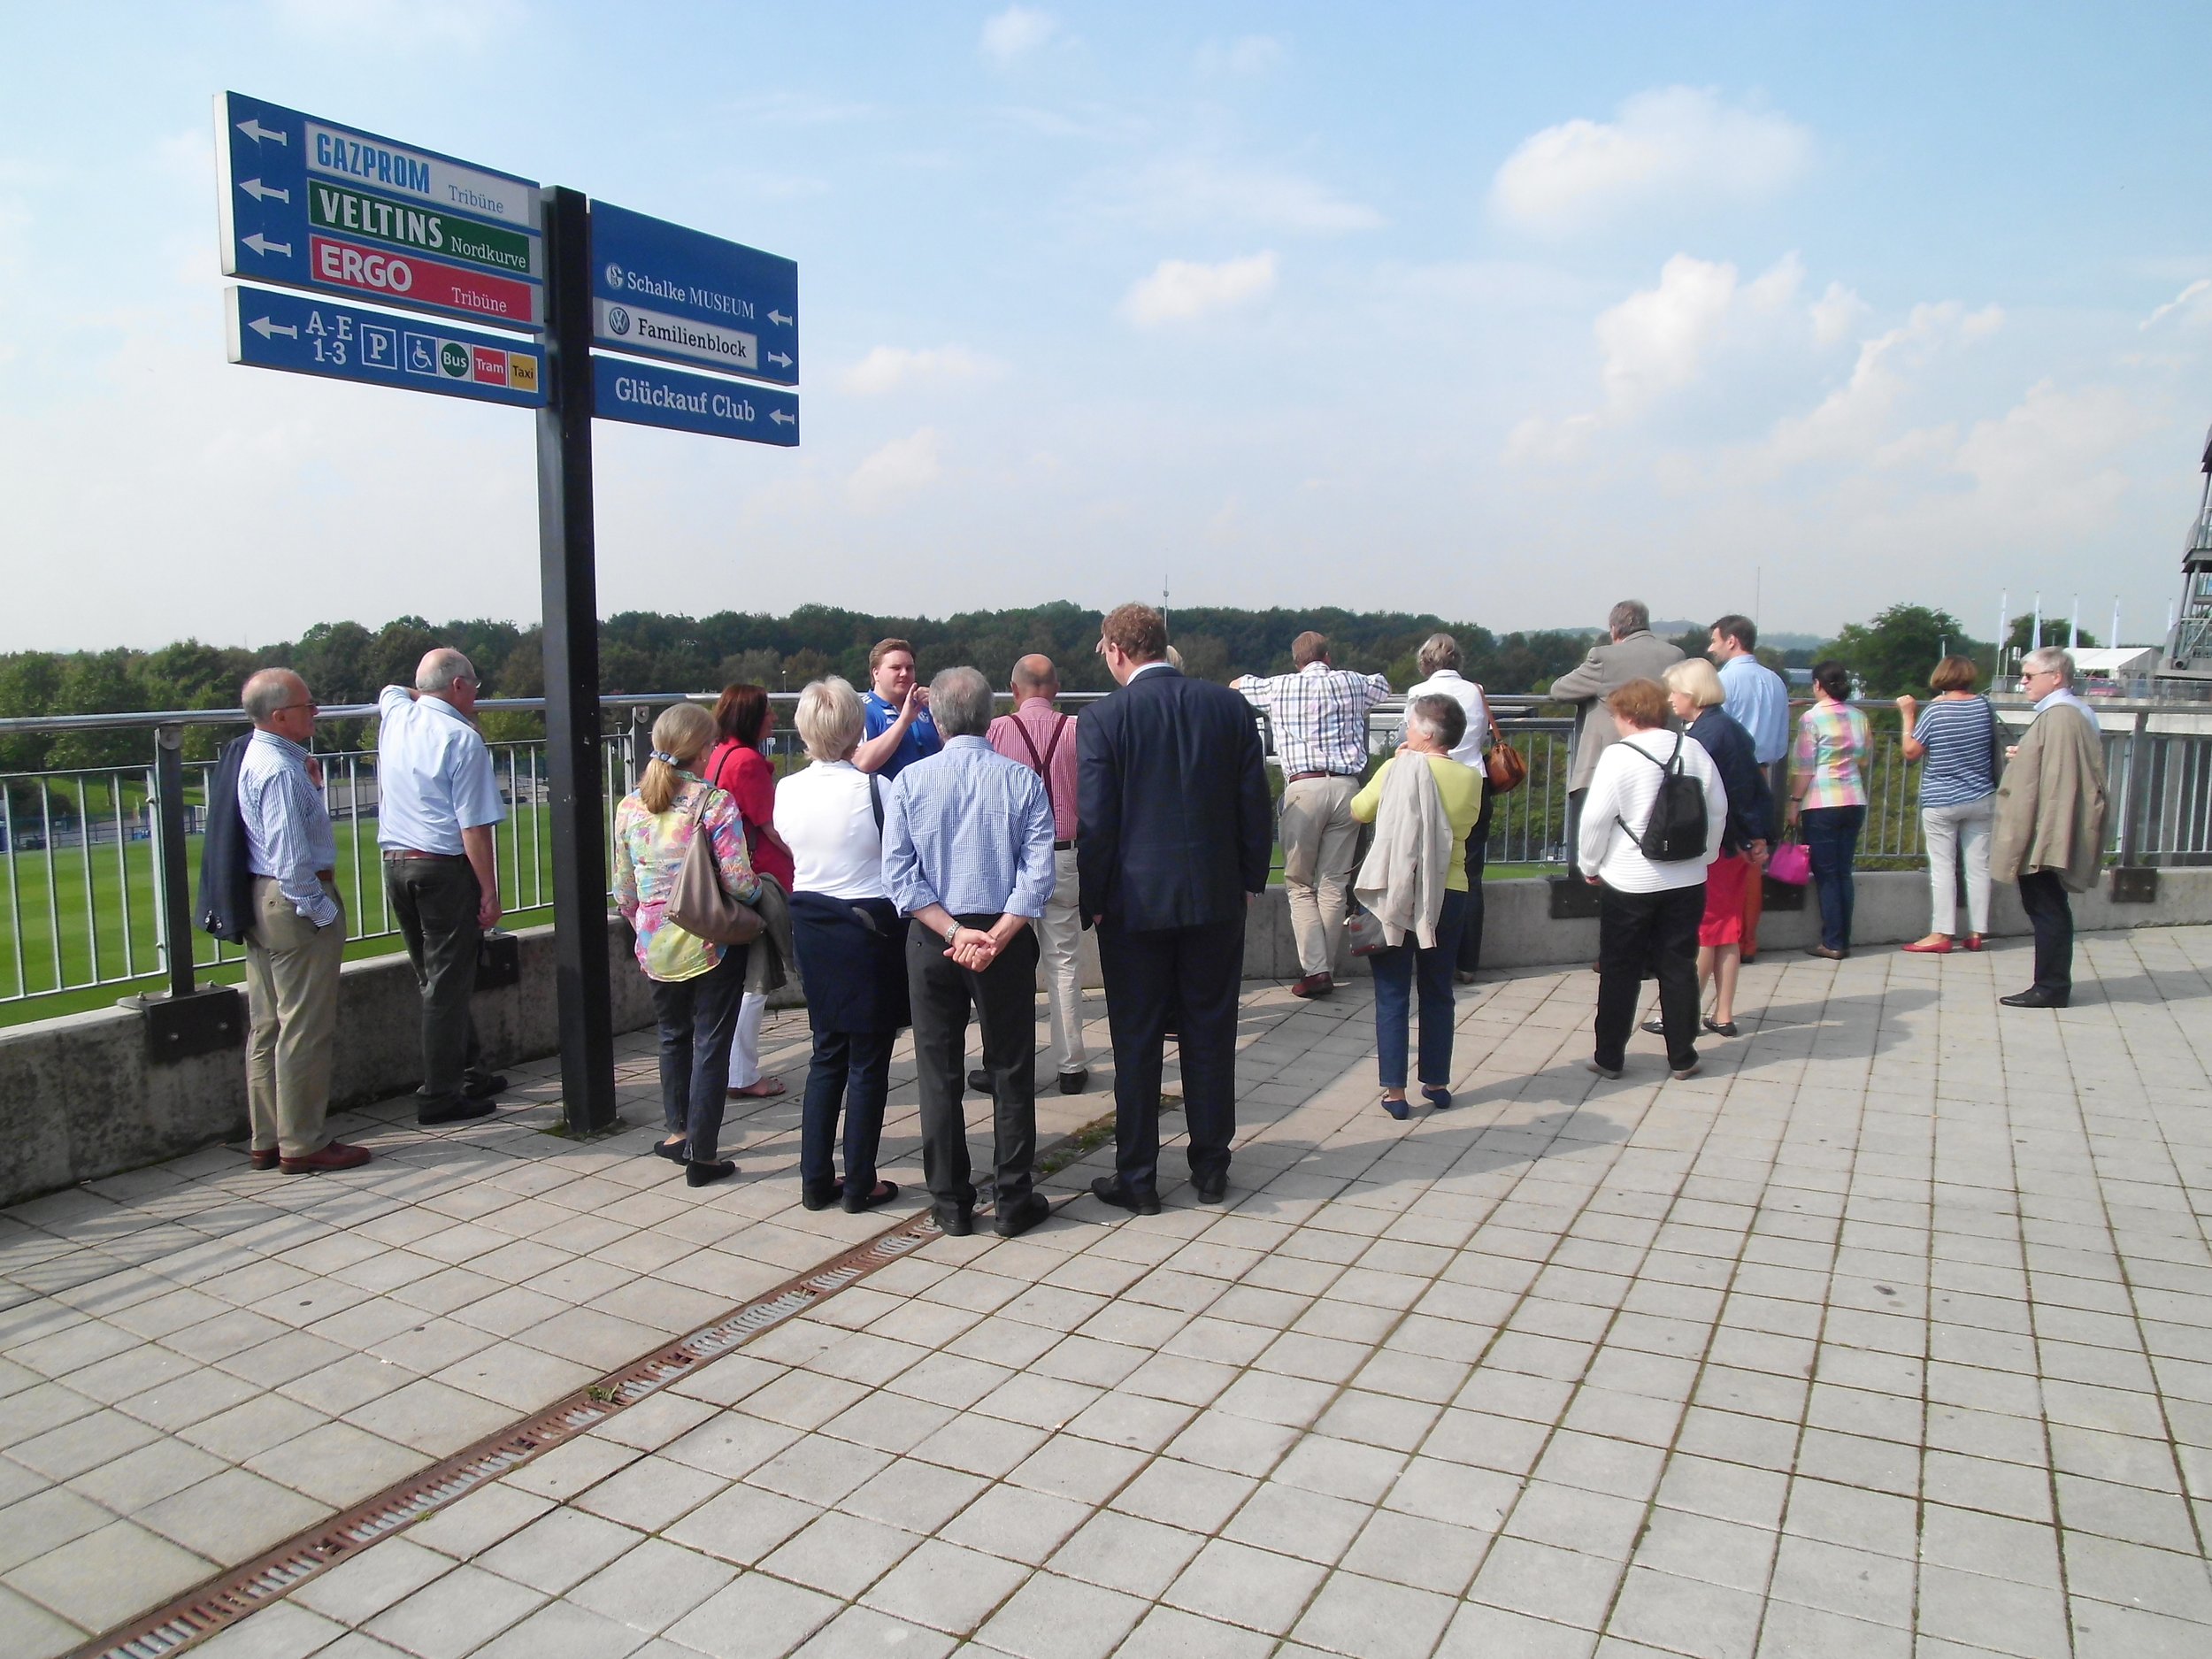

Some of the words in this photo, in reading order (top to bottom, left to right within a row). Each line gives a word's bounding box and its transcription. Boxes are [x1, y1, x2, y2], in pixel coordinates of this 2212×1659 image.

[316, 132, 430, 195] GAZPROM
[449, 184, 504, 214] Tribüne
[319, 188, 443, 249] VELTINS
[450, 236, 526, 269] Nordkurve
[321, 243, 413, 292] ERGO
[451, 287, 507, 313] Tribüne
[626, 270, 686, 303] Schalke
[688, 286, 755, 319] MUSEUM
[305, 311, 353, 342] A-E
[637, 317, 747, 358] Familienblock
[313, 338, 347, 365] 1-3
[369, 333, 388, 360] P
[443, 351, 467, 368] Bus
[475, 357, 504, 374] Tram
[512, 365, 534, 380] Taxi
[615, 376, 708, 414] Glückauf
[712, 393, 756, 423] Club
